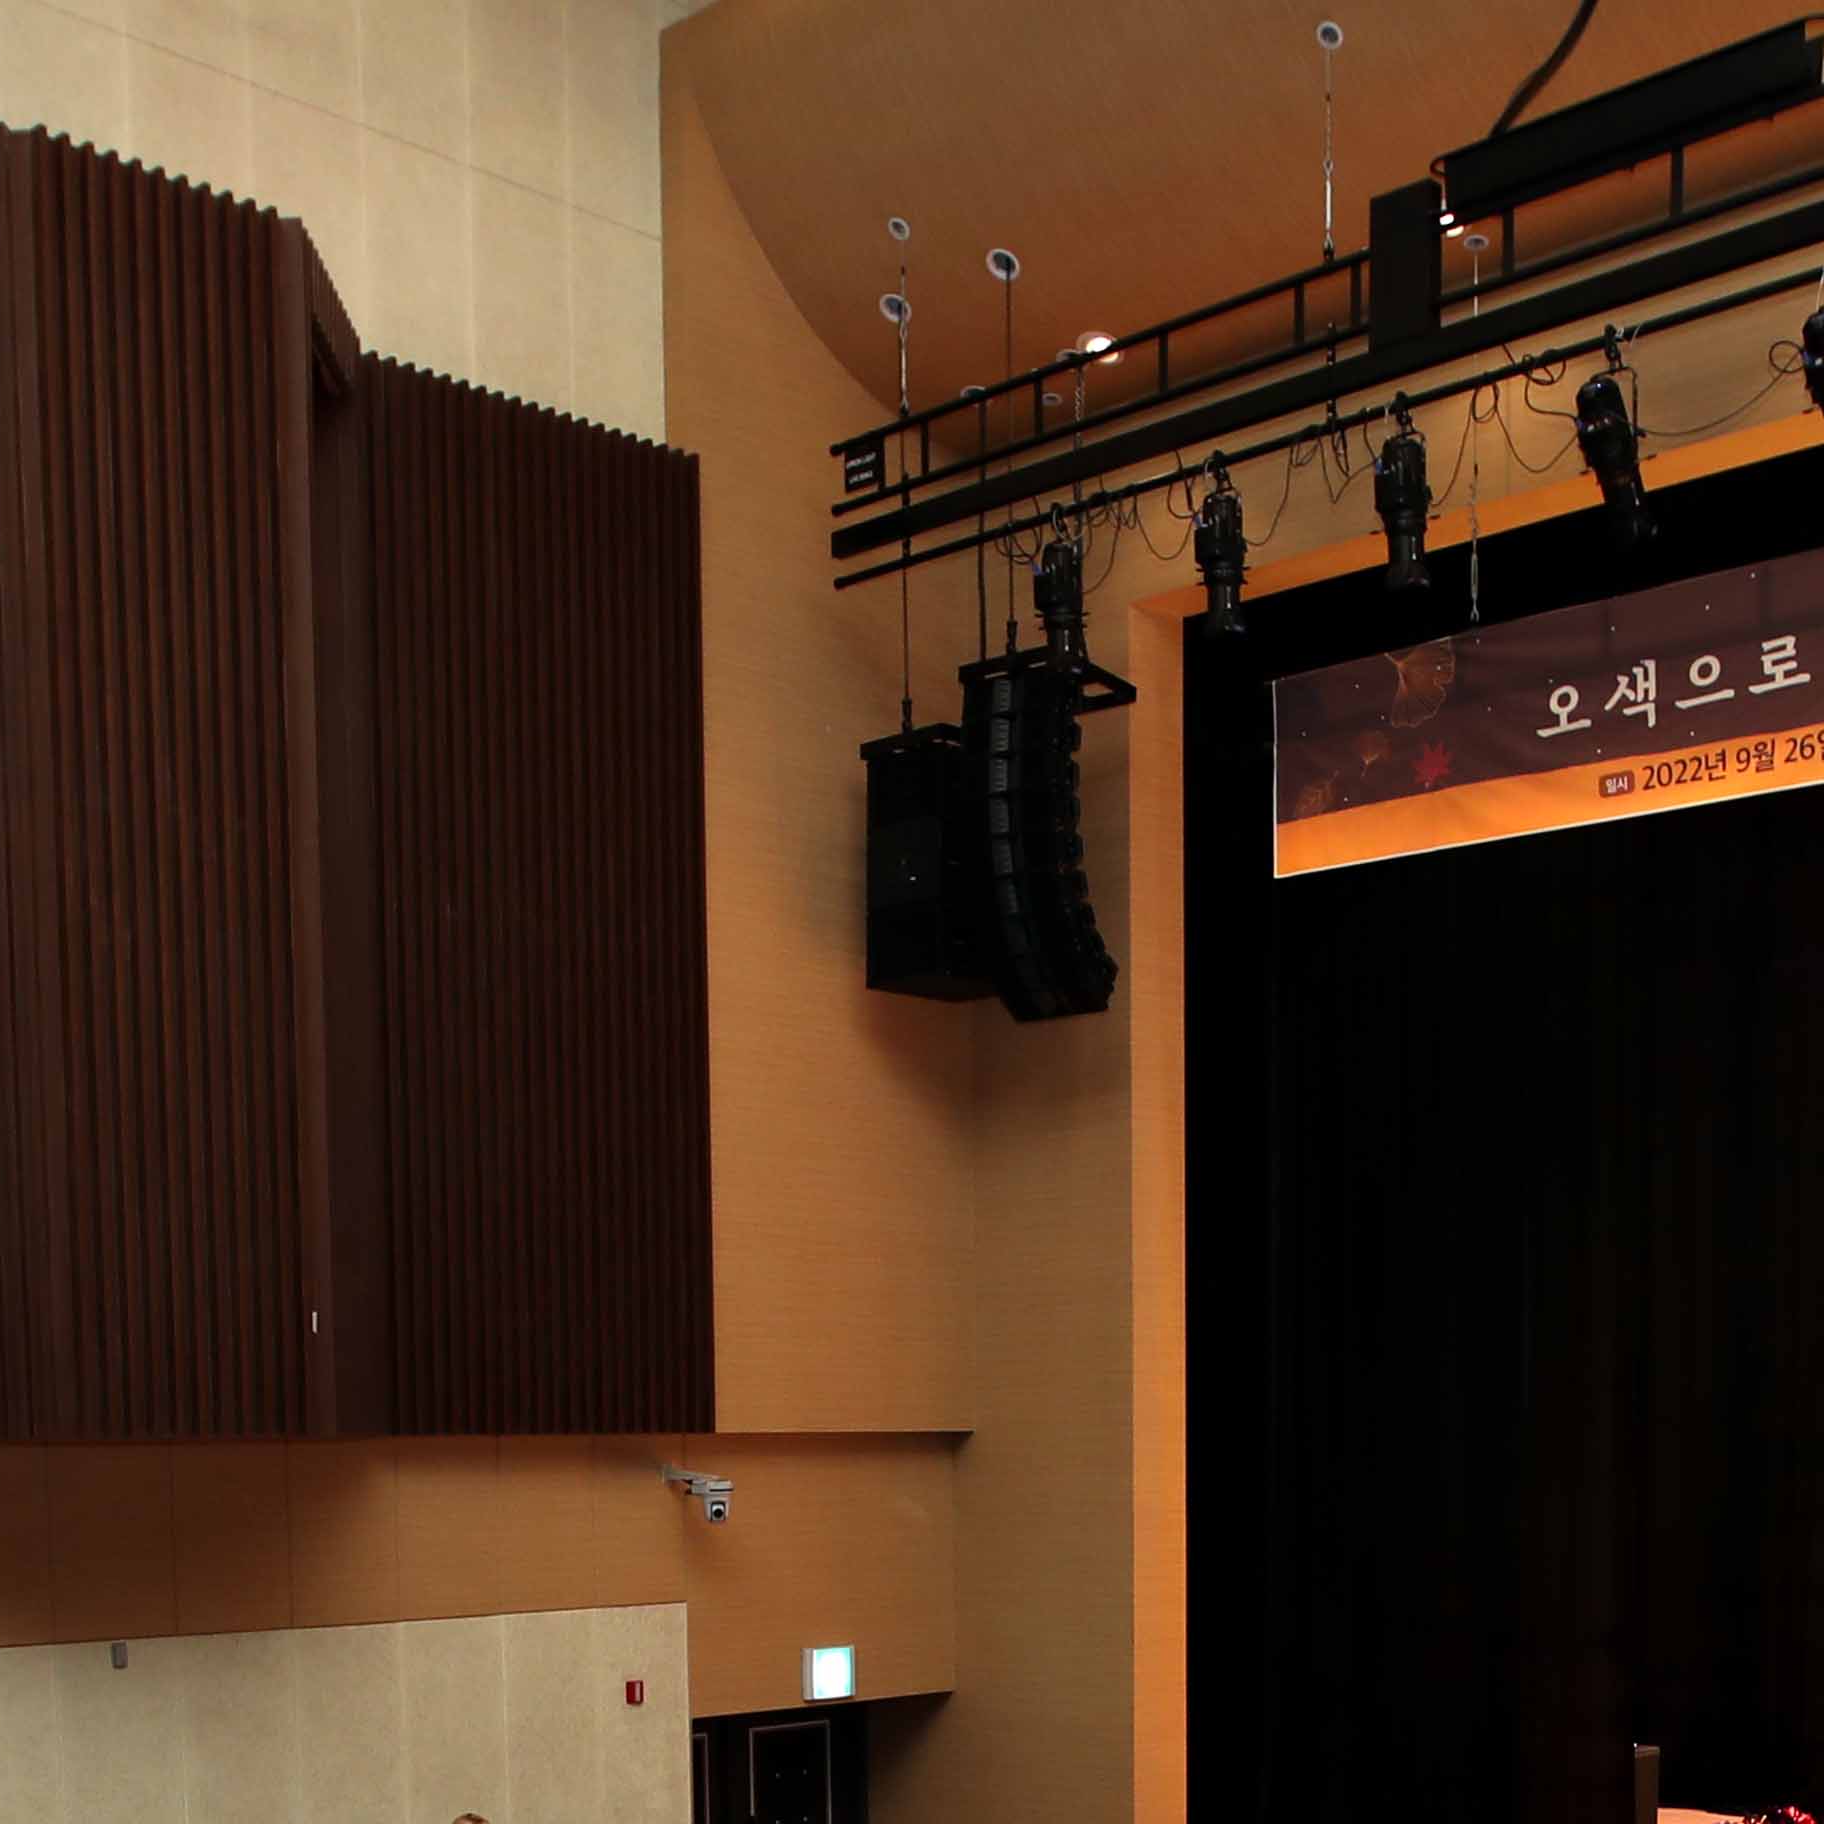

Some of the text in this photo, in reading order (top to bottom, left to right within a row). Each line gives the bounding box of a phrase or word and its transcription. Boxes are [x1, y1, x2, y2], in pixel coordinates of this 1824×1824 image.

[1536, 635, 1812, 739] 오색으로
[1605, 776, 1629, 795] 일시
[1642, 752, 1727, 791] 2022년
[1736, 740, 1776, 773] 9월
